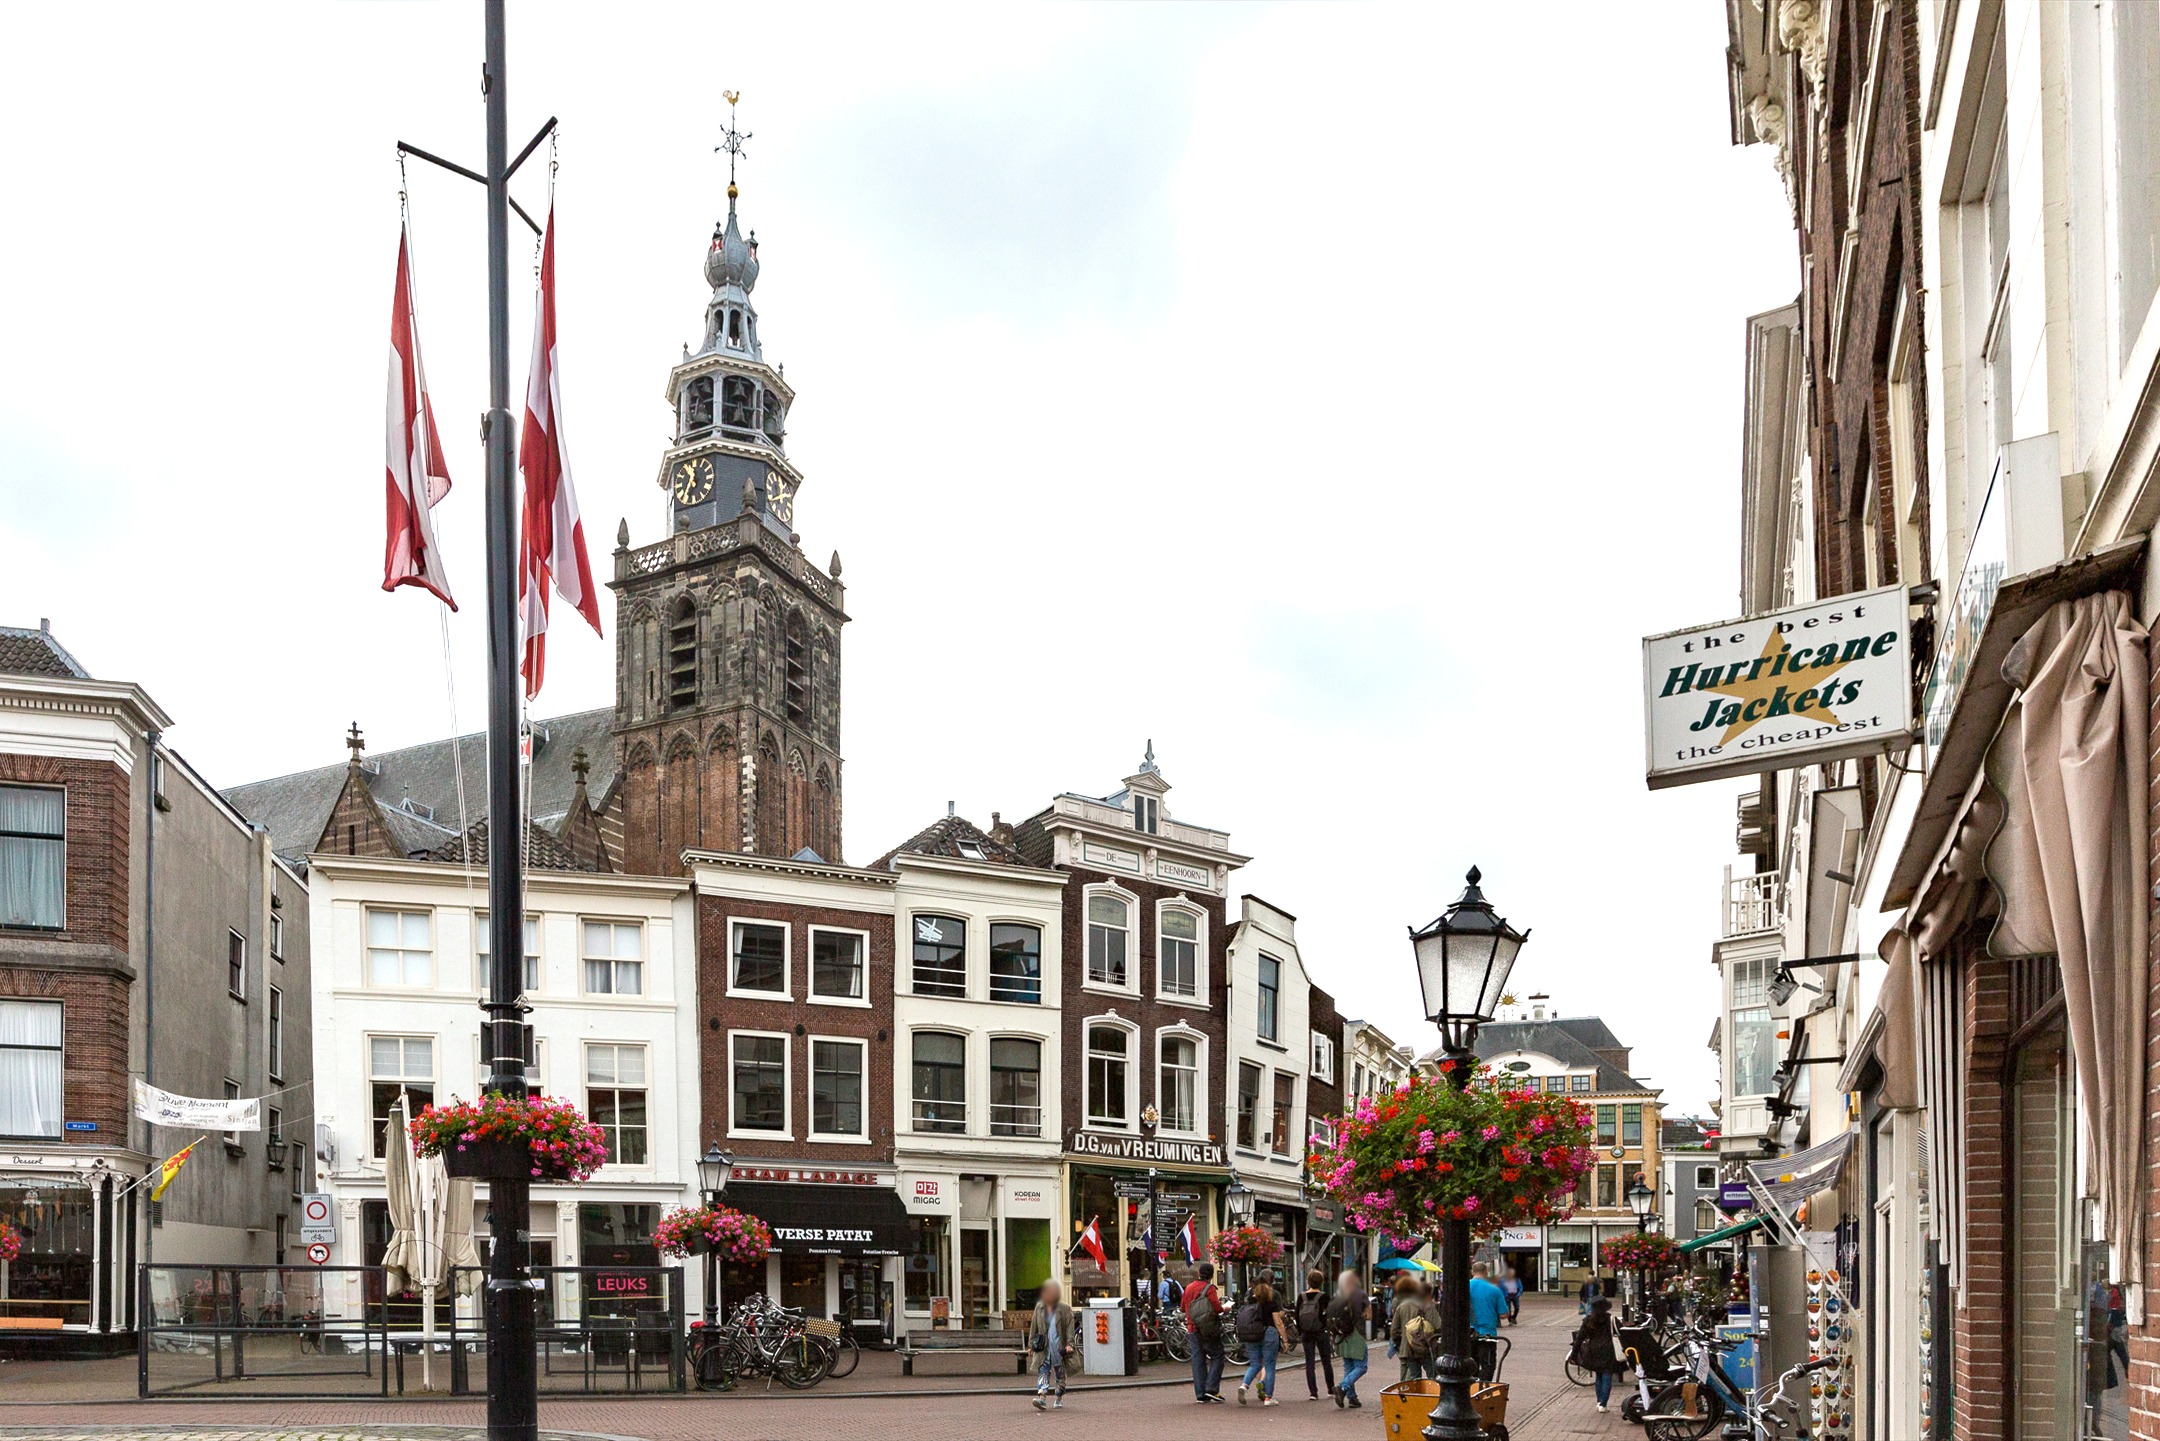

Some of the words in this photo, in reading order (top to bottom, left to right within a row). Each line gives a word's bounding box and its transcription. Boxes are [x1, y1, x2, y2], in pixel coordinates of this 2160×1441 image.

[1683, 633, 1745, 653] the
[1775, 605, 1866, 634] best
[1658, 631, 1898, 698] Hurricane
[1689, 677, 1864, 732] Jackets
[1675, 745, 1724, 761] the
[1741, 715, 1882, 750] cheapest
[1106, 852, 1117, 862] DE
[1163, 864, 1201, 880] EENHOORN
[12, 1155, 43, 1165] Dessert
[731, 1167, 790, 1181] BRAM
[798, 1170, 878, 1185] LADAGE
[917, 1182, 937, 1195] 미각
[913, 1196, 941, 1205] MIGAG
[774, 1227, 824, 1241] VERSE
[826, 1229, 873, 1242] PATAT
[1504, 1231, 1524, 1240] ING
[597, 1277, 647, 1291] LEUKS
